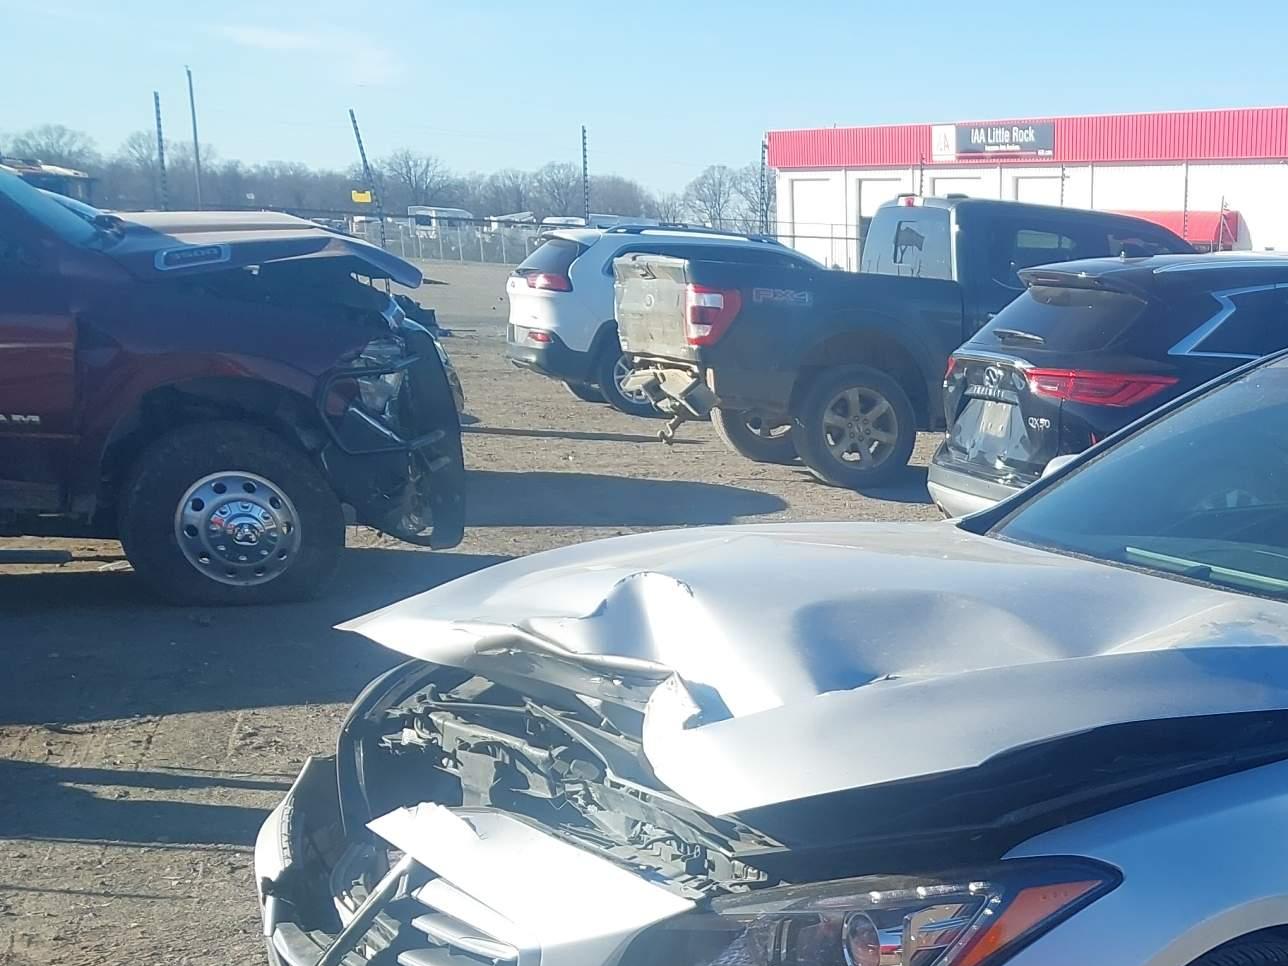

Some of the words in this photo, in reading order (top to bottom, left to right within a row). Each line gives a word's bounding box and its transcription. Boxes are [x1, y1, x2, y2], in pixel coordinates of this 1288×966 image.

[971, 128, 985, 144] IAA
[988, 127, 1010, 143] Little
[1012, 126, 1035, 142] Rock
[0, 413, 40, 424] AM
[1028, 416, 1051, 430] QX50
